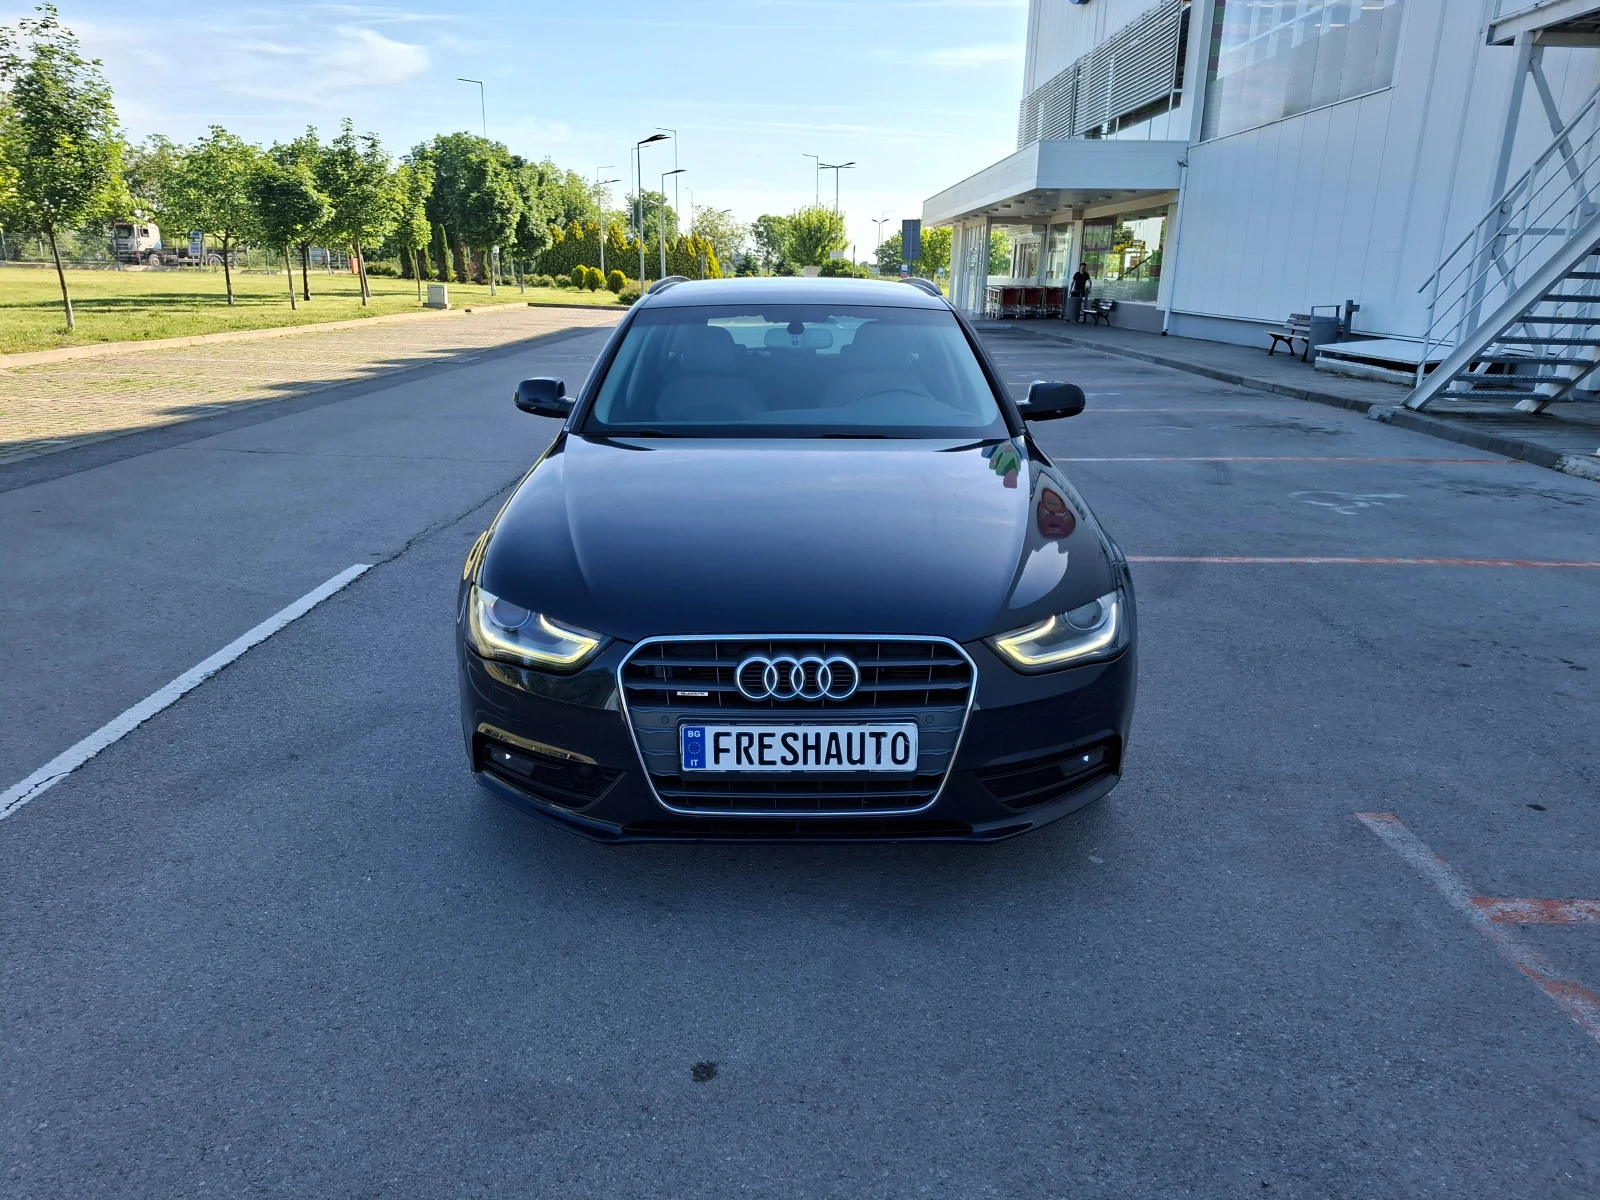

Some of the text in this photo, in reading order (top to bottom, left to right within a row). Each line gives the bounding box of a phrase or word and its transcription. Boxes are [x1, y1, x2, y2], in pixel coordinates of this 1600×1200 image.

[687, 730, 701, 738] BG
[713, 731, 909, 766] FRESHAUTO
[690, 759, 699, 767] IT
